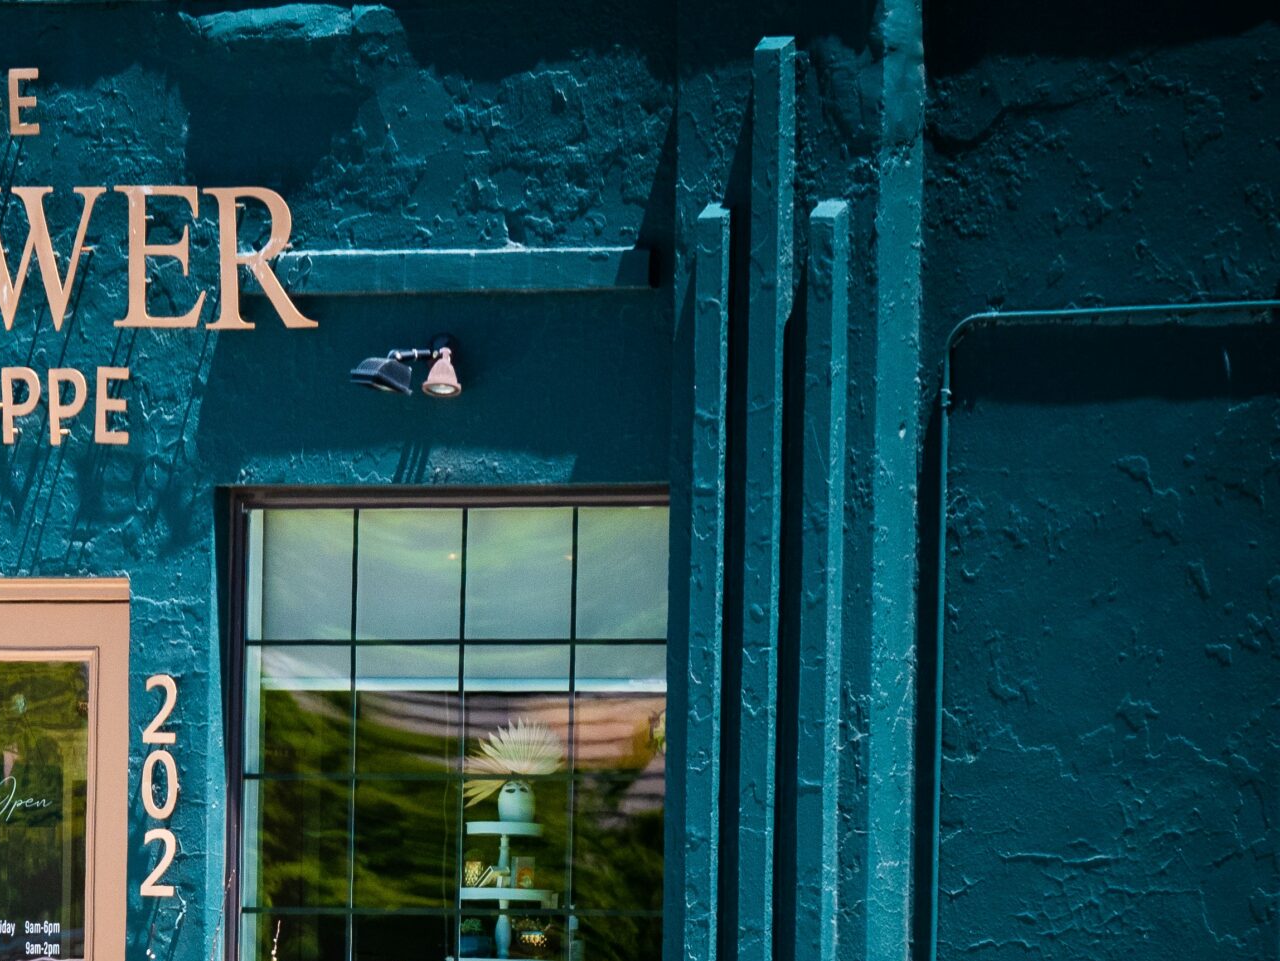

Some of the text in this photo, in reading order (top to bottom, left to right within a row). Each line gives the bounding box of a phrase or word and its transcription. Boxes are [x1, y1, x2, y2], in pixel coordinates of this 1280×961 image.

[141, 674, 178, 896] 202
[25, 920, 60, 936] 9am-6pm
[25, 941, 60, 957] 9am-2pm
